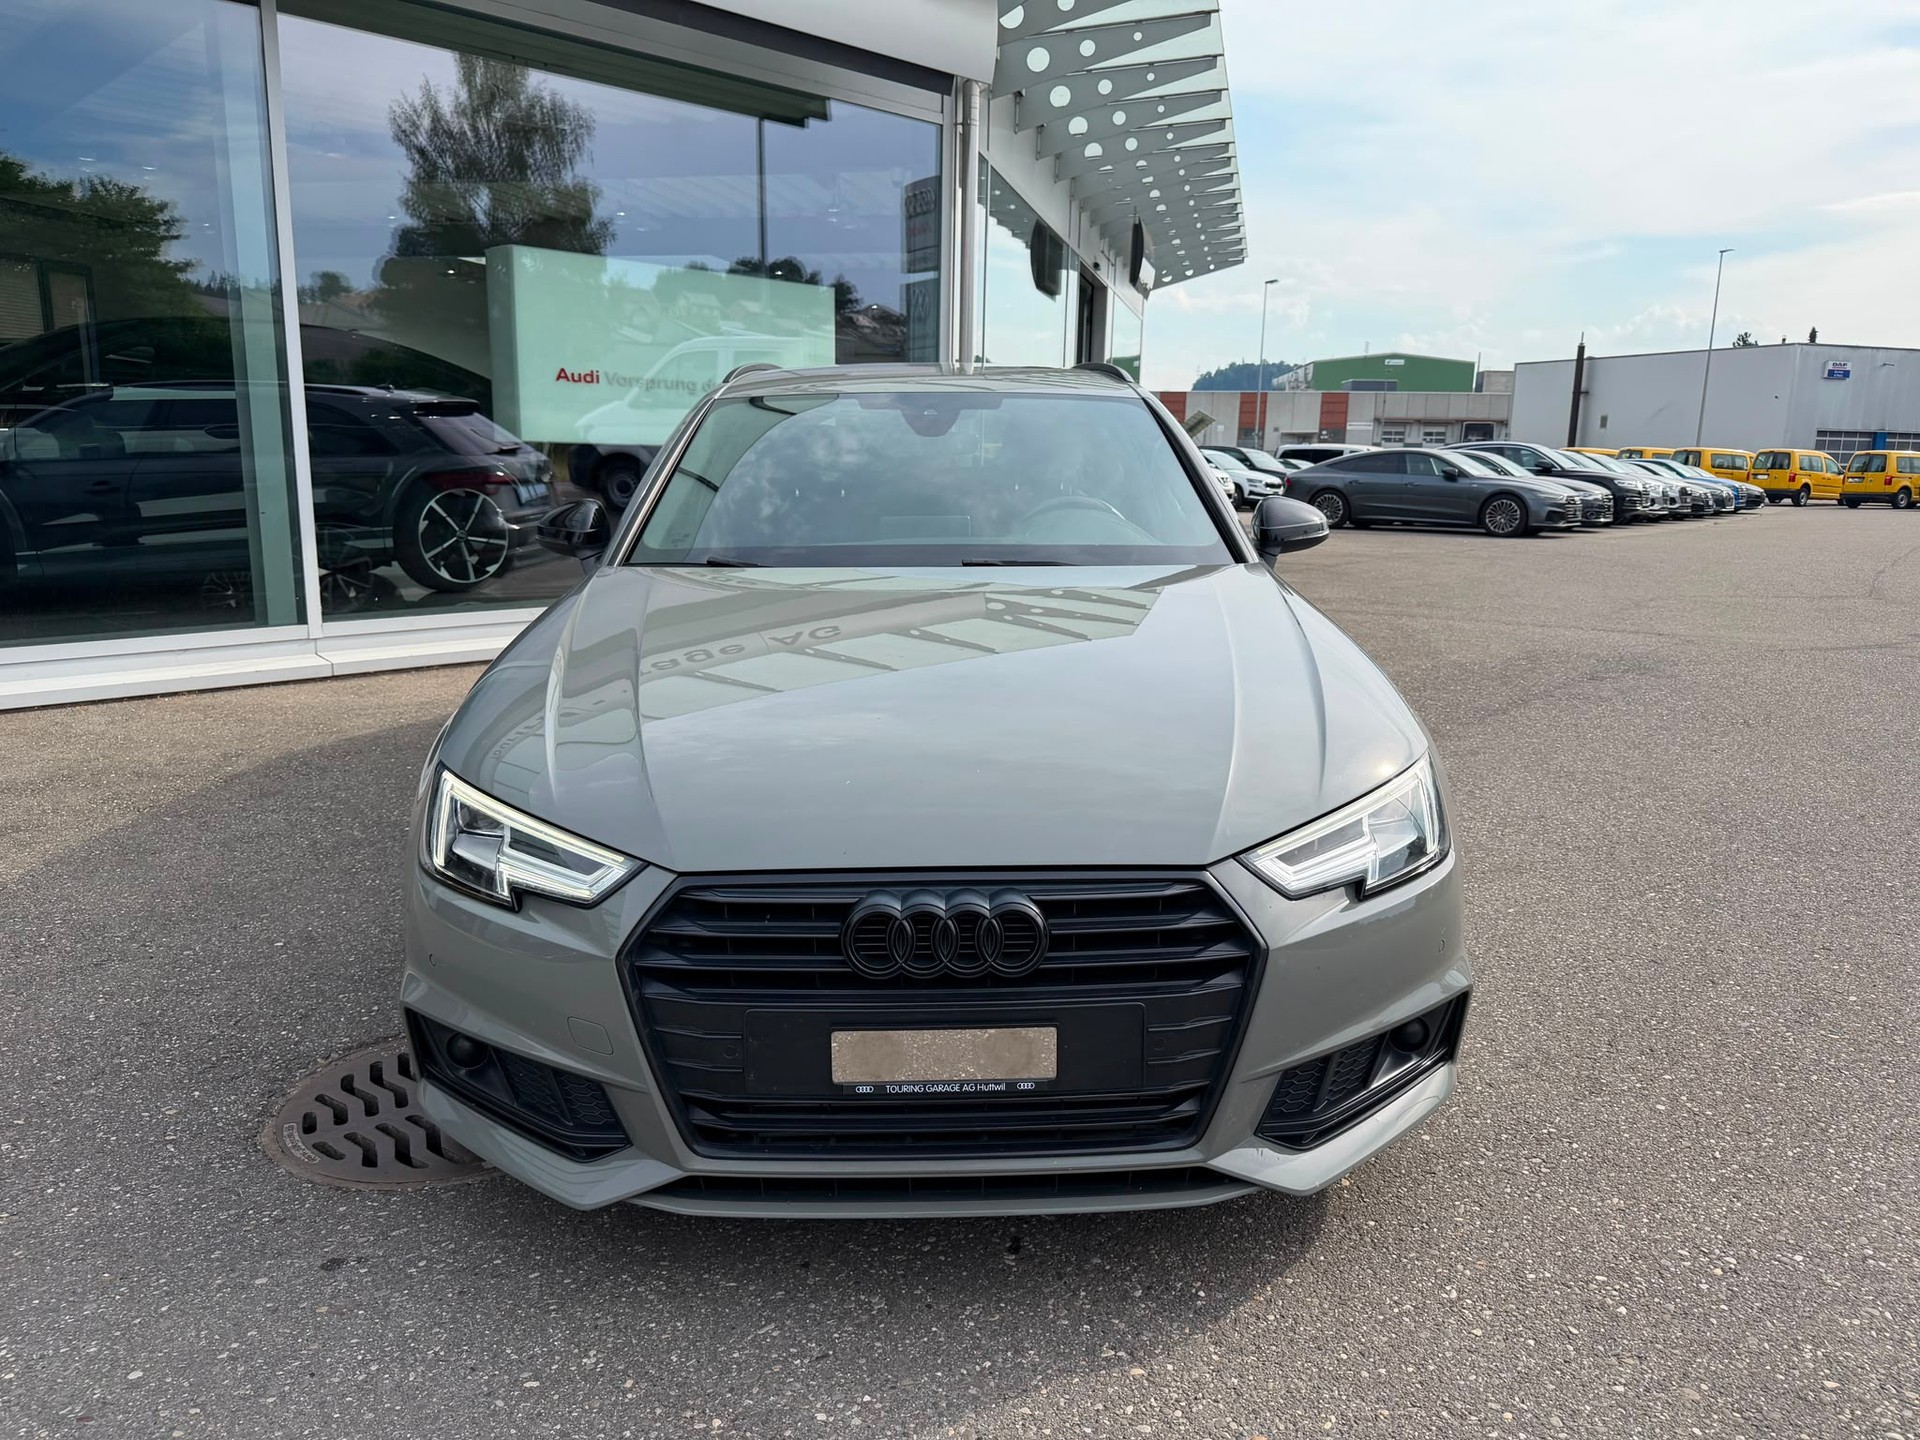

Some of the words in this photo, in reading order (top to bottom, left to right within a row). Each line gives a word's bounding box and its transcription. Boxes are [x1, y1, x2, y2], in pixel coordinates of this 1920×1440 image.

[556, 368, 600, 384] Audi
[603, 371, 697, 394] Vorsprung
[886, 1085, 924, 1093] TOURING
[925, 1084, 961, 1093] GARAGE
[962, 1083, 976, 1092] AG
[977, 1082, 1006, 1091] Huttwil
